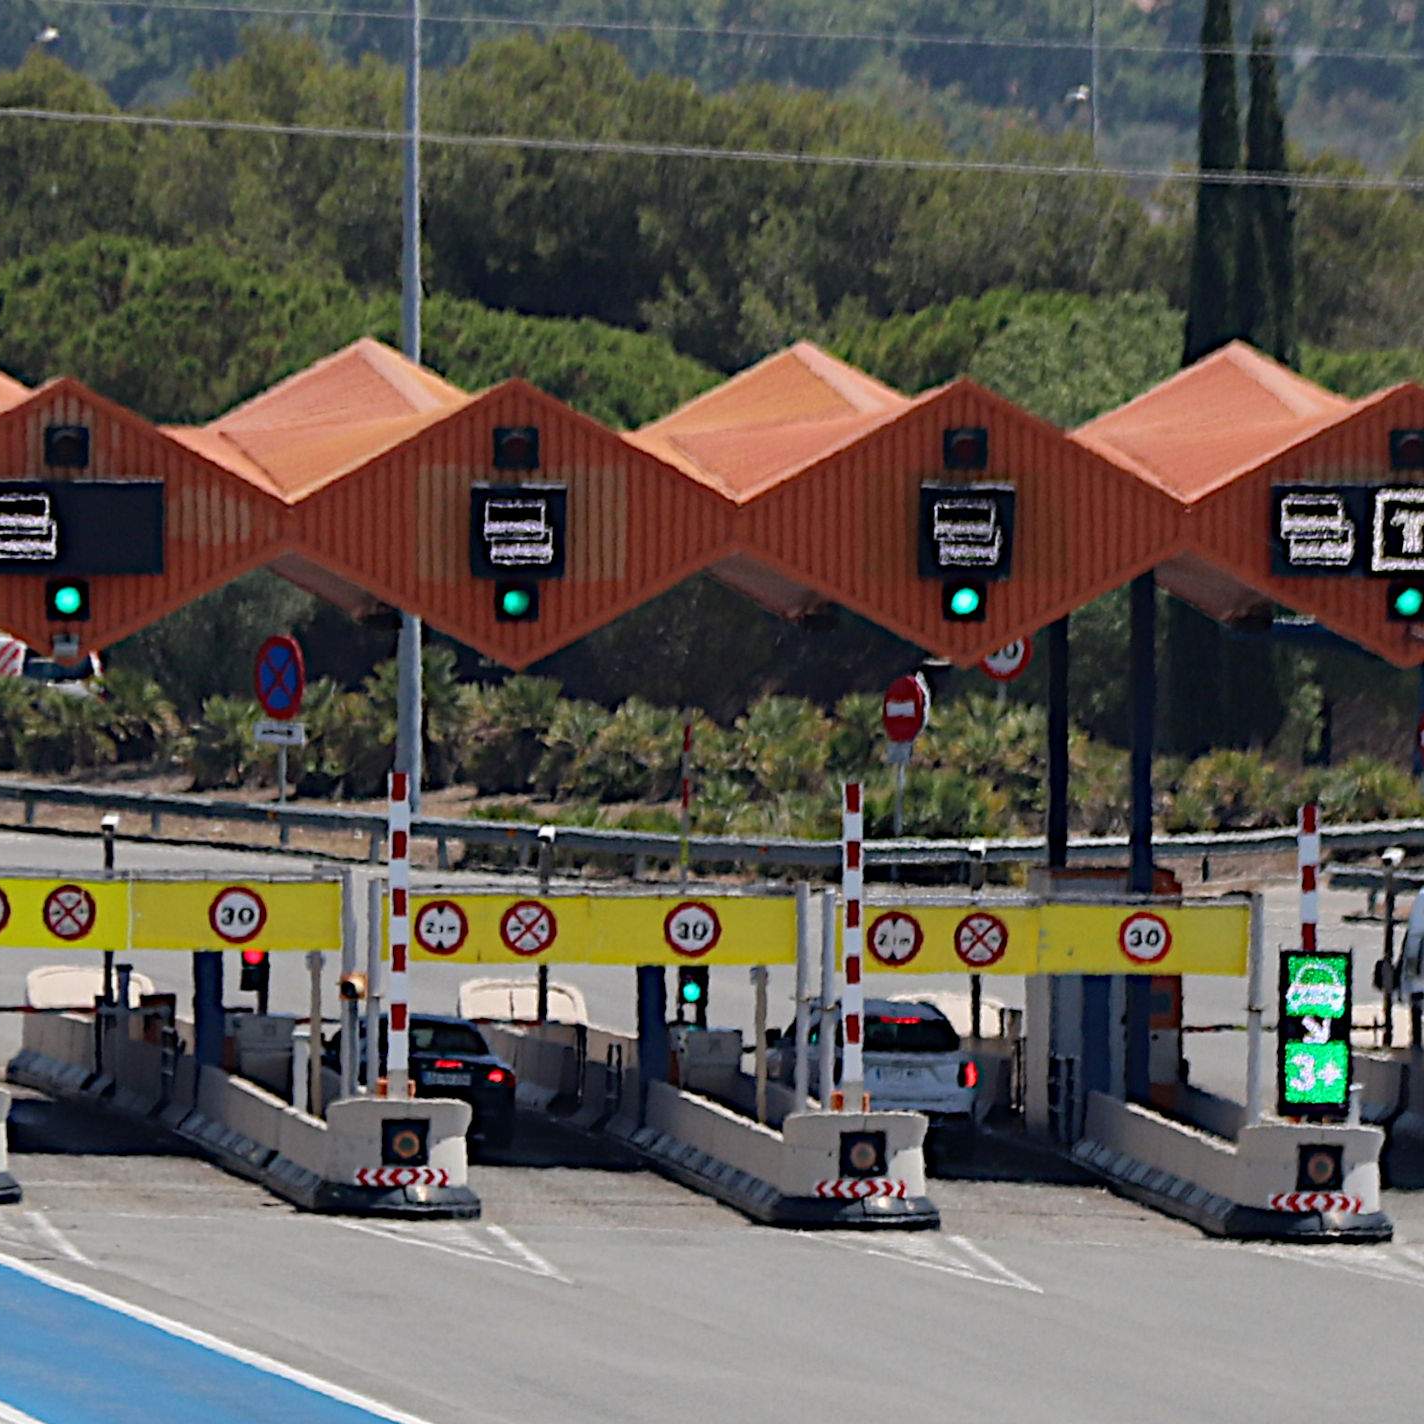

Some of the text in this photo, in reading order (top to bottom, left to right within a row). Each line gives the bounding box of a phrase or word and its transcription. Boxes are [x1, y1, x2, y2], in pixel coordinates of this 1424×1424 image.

[220, 905, 255, 926] 30
[676, 921, 708, 941] 30
[1129, 928, 1161, 948] 30
[1289, 1052, 1344, 1092] 3+
